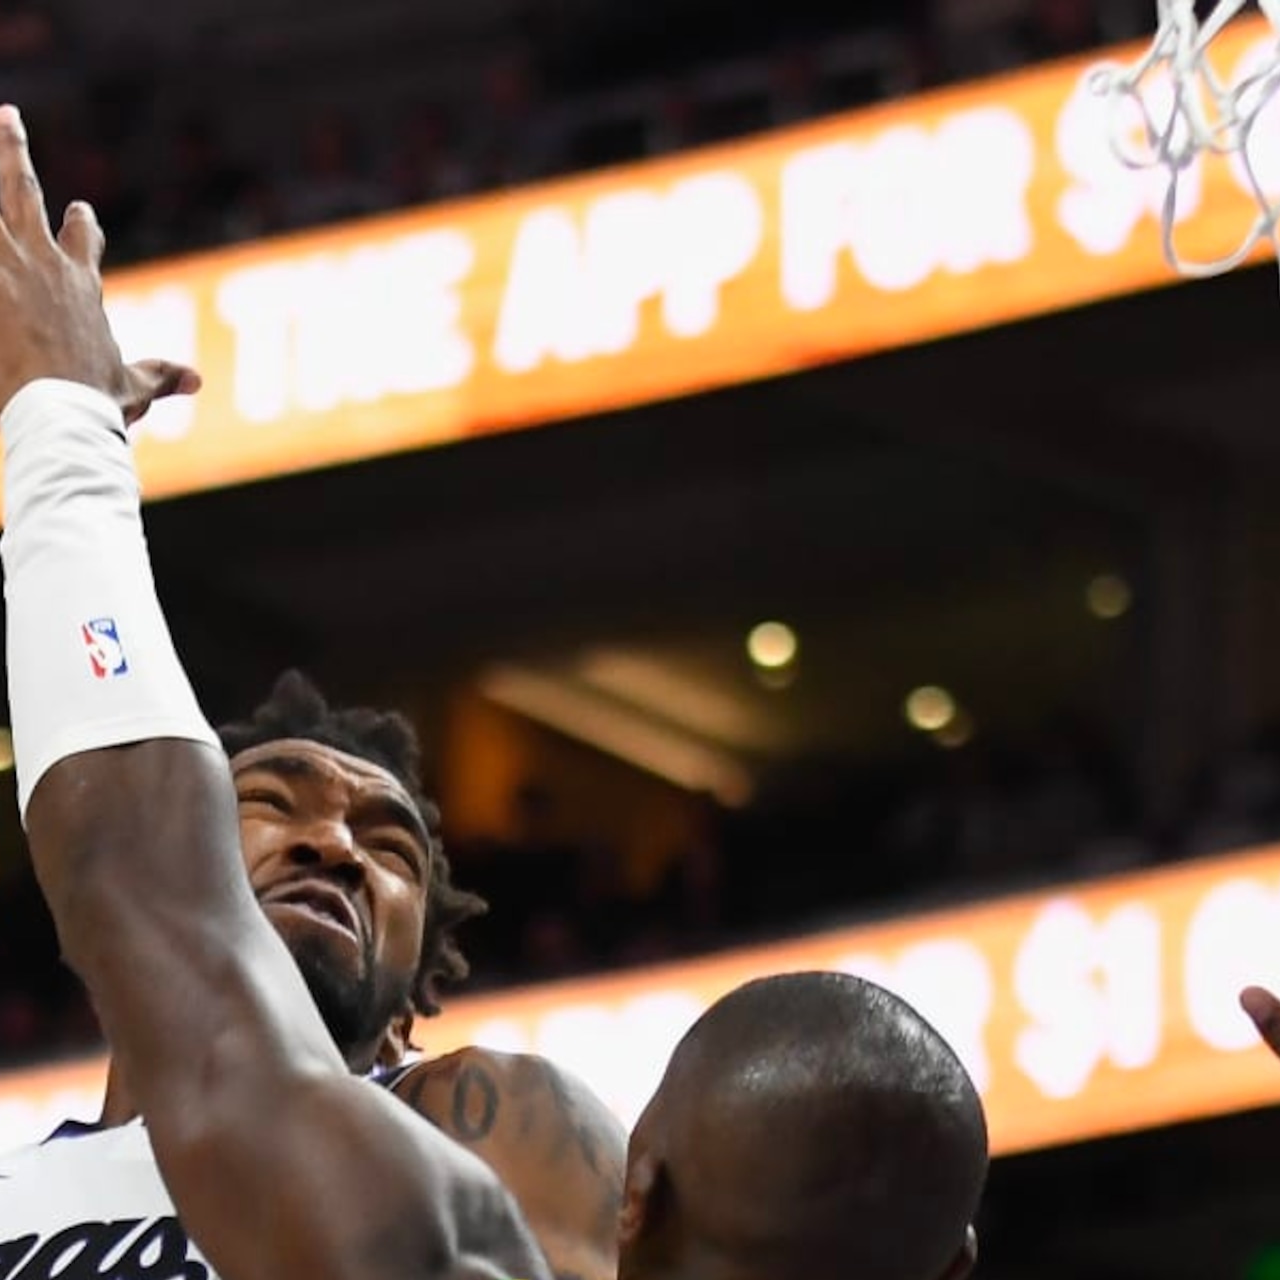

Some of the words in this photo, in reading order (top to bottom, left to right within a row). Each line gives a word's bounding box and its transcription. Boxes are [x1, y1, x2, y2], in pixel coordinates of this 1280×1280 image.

[217, 228, 476, 424] THE
[492, 172, 762, 374] APP
[780, 105, 1037, 312] FOR
[1011, 896, 1165, 1100] $1
